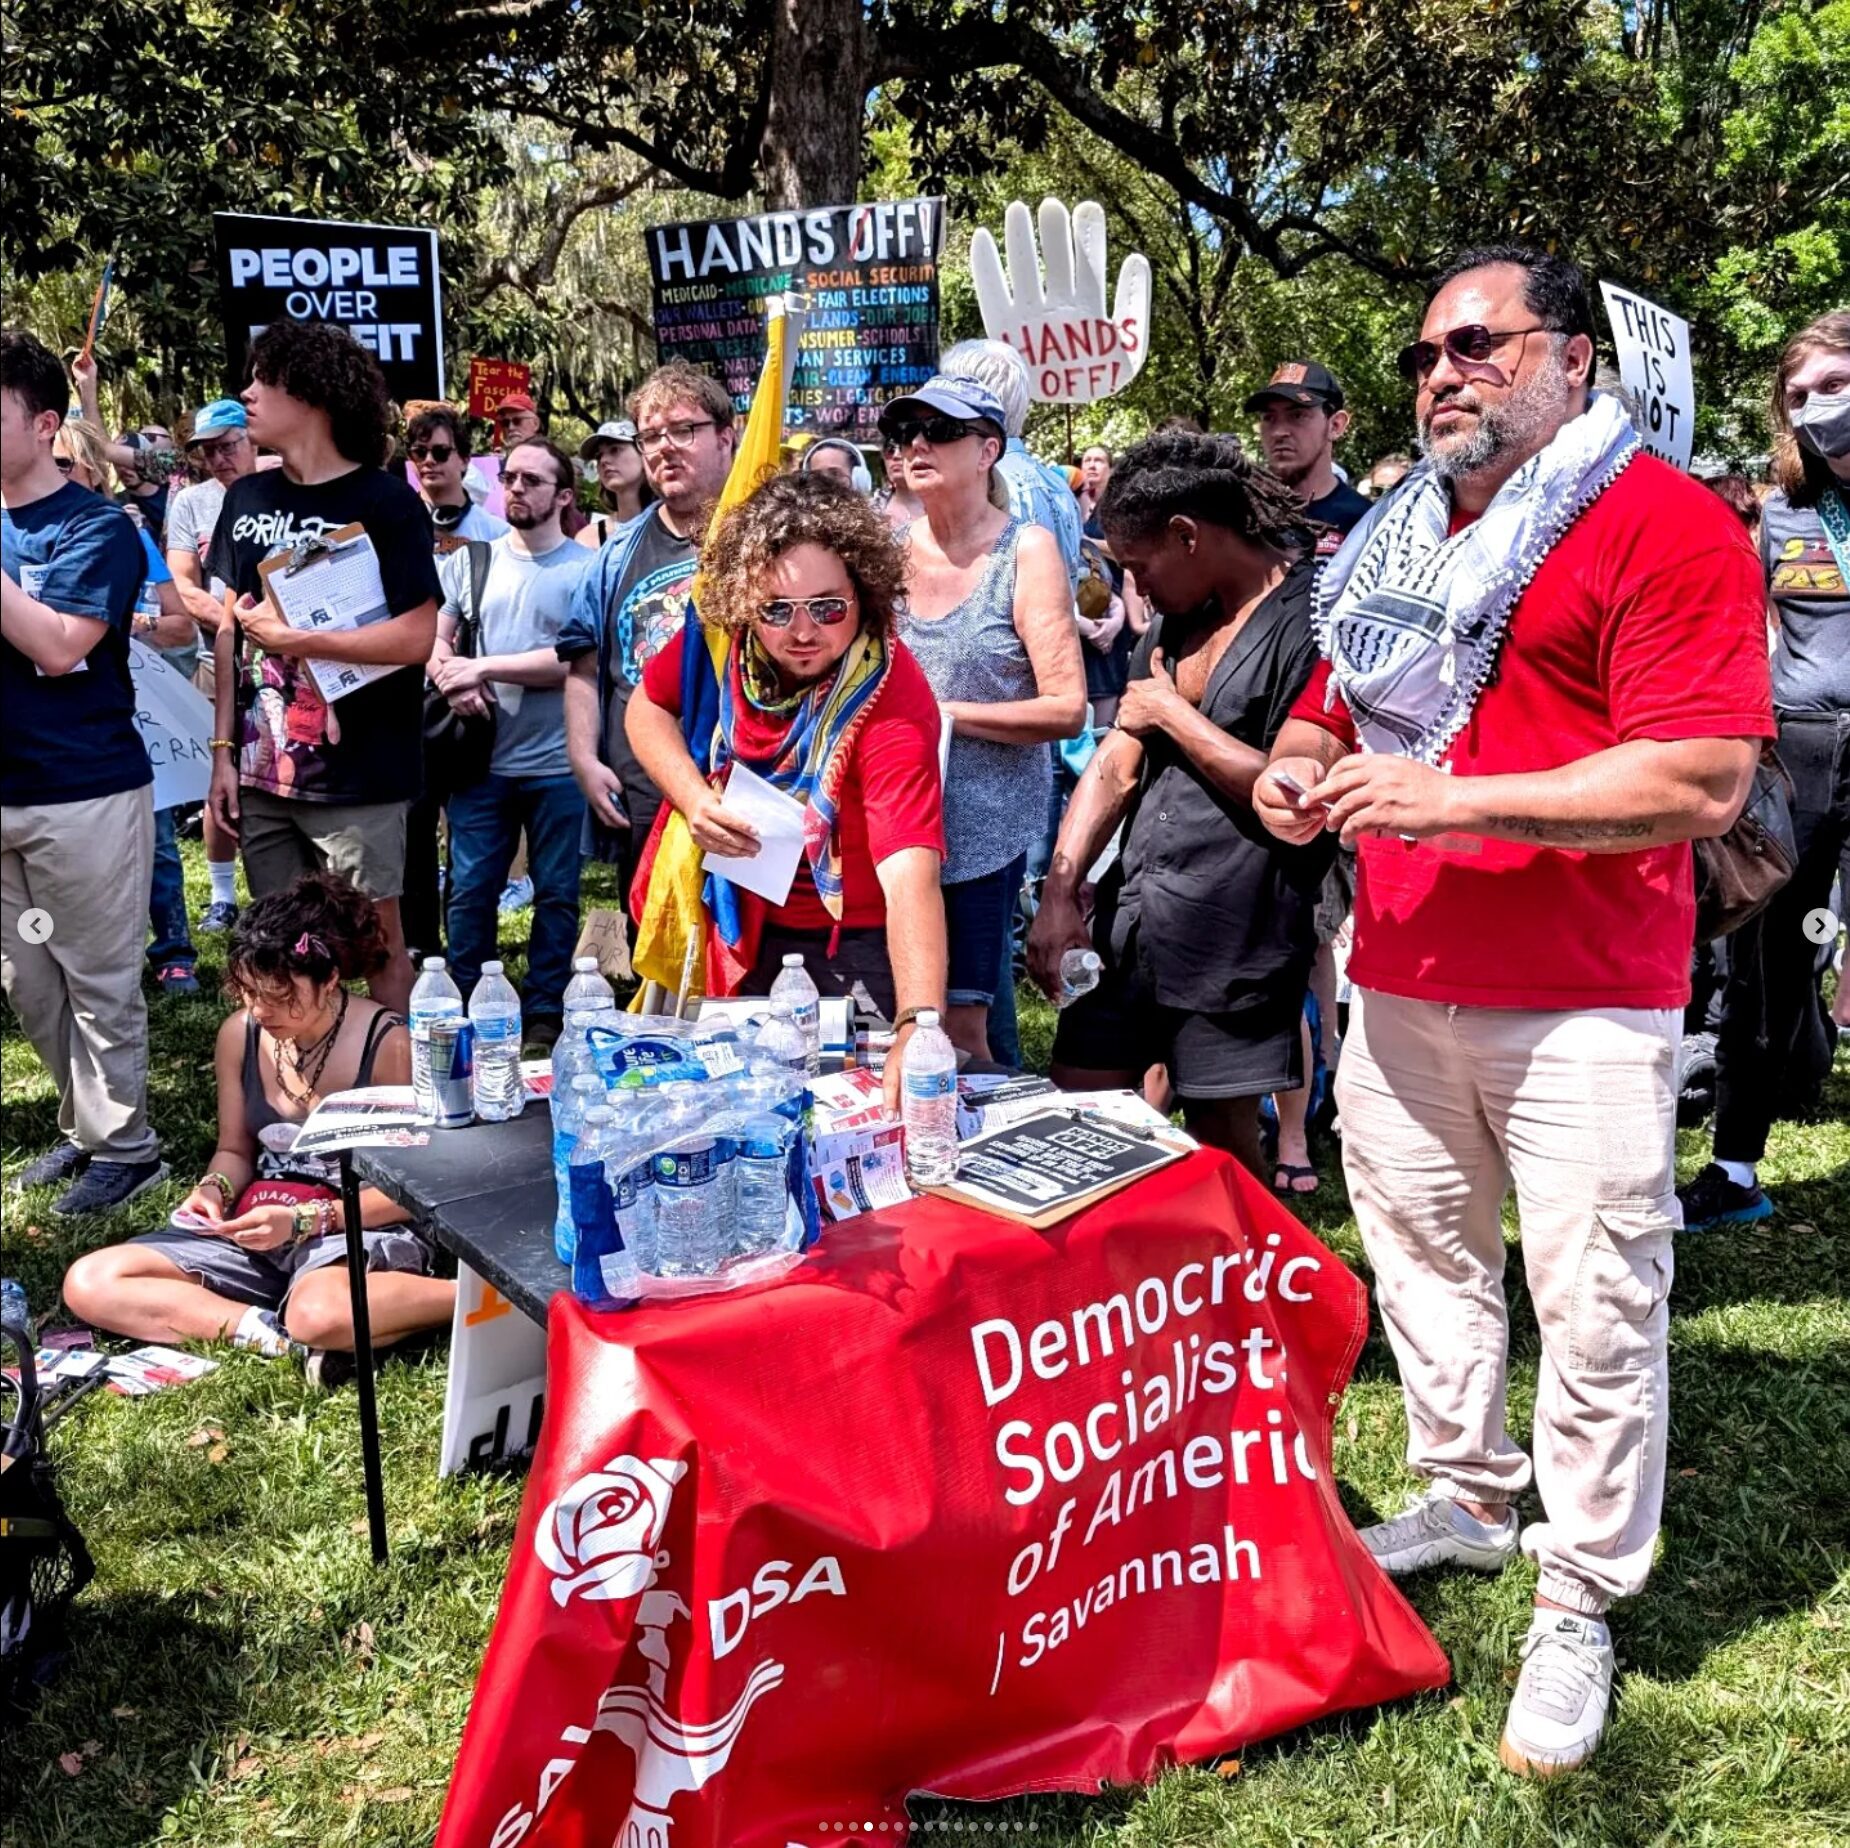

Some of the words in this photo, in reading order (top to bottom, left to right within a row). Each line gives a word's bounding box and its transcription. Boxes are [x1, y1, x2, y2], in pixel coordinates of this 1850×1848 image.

[656, 209, 835, 281] HANDS
[848, 203, 932, 262] OFF!
[229, 246, 420, 287] PEOPLE
[807, 270, 863, 289] SOCIAL
[286, 291, 379, 319] OVER
[818, 291, 848, 309] FAIR
[852, 286, 930, 307] ELECTIONS
[658, 321, 724, 343] PERSONAL
[865, 307, 897, 326] OUR
[862, 326, 921, 345] SCHOOLS
[1002, 318, 1139, 366] HANDS
[1611, 293, 1676, 359] THIS
[833, 347, 906, 367] SERVICES
[880, 365, 936, 383] ENERGY
[1642, 351, 1667, 396] IS
[1041, 362, 1121, 397] OFF!
[1007, 1498, 1077, 1597] of
[1083, 1410, 1319, 1548] Americ
[708, 1556, 847, 1661] DSA
[1019, 1525, 1262, 1668] Savannah
